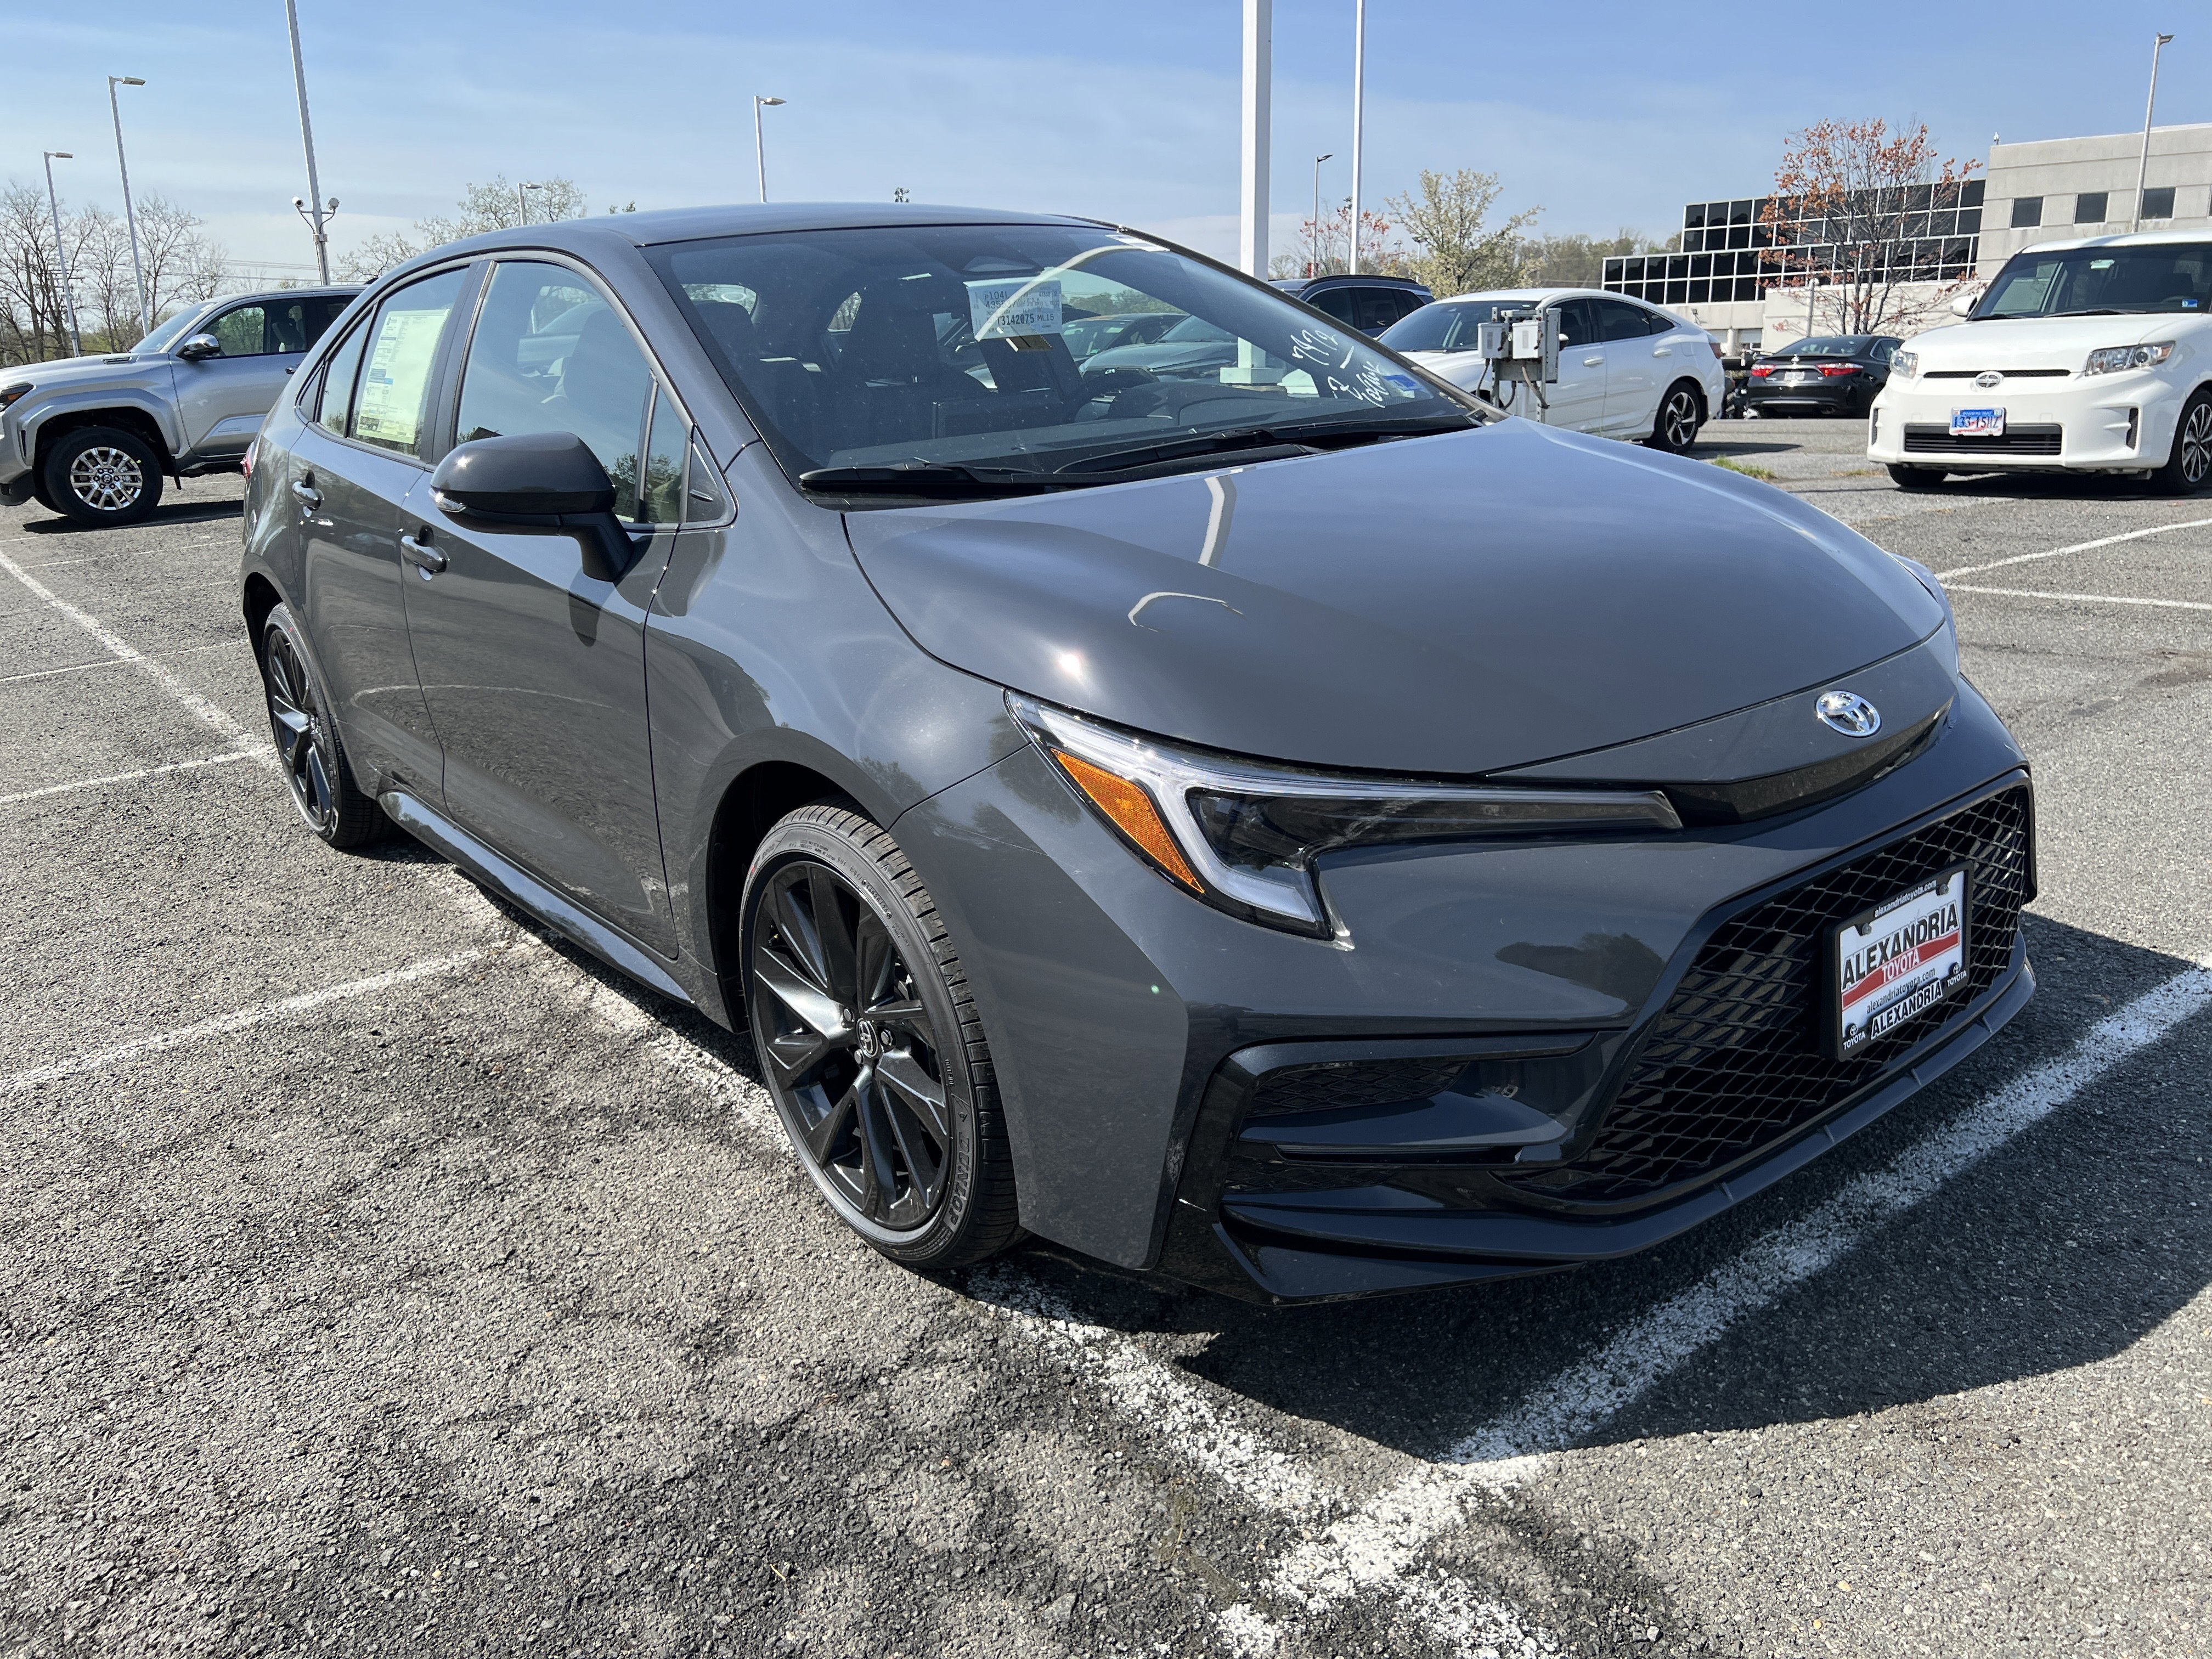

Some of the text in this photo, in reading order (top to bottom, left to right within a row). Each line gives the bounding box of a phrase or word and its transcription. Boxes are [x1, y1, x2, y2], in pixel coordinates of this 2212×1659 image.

[1874, 880, 1937, 917] alexandriatoyota.com
[1842, 901, 1960, 991] ALEXANDRIA
[1882, 949, 1920, 984] TOYOTA
[1866, 968, 1936, 1014] alexandriatoyota.com
[1947, 969, 1967, 988] TOYOTA
[1871, 980, 1943, 1040] ALEXANDRIA
[1843, 1031, 1866, 1050] TOYOTA
[948, 1131, 970, 1226] DUNLOP
